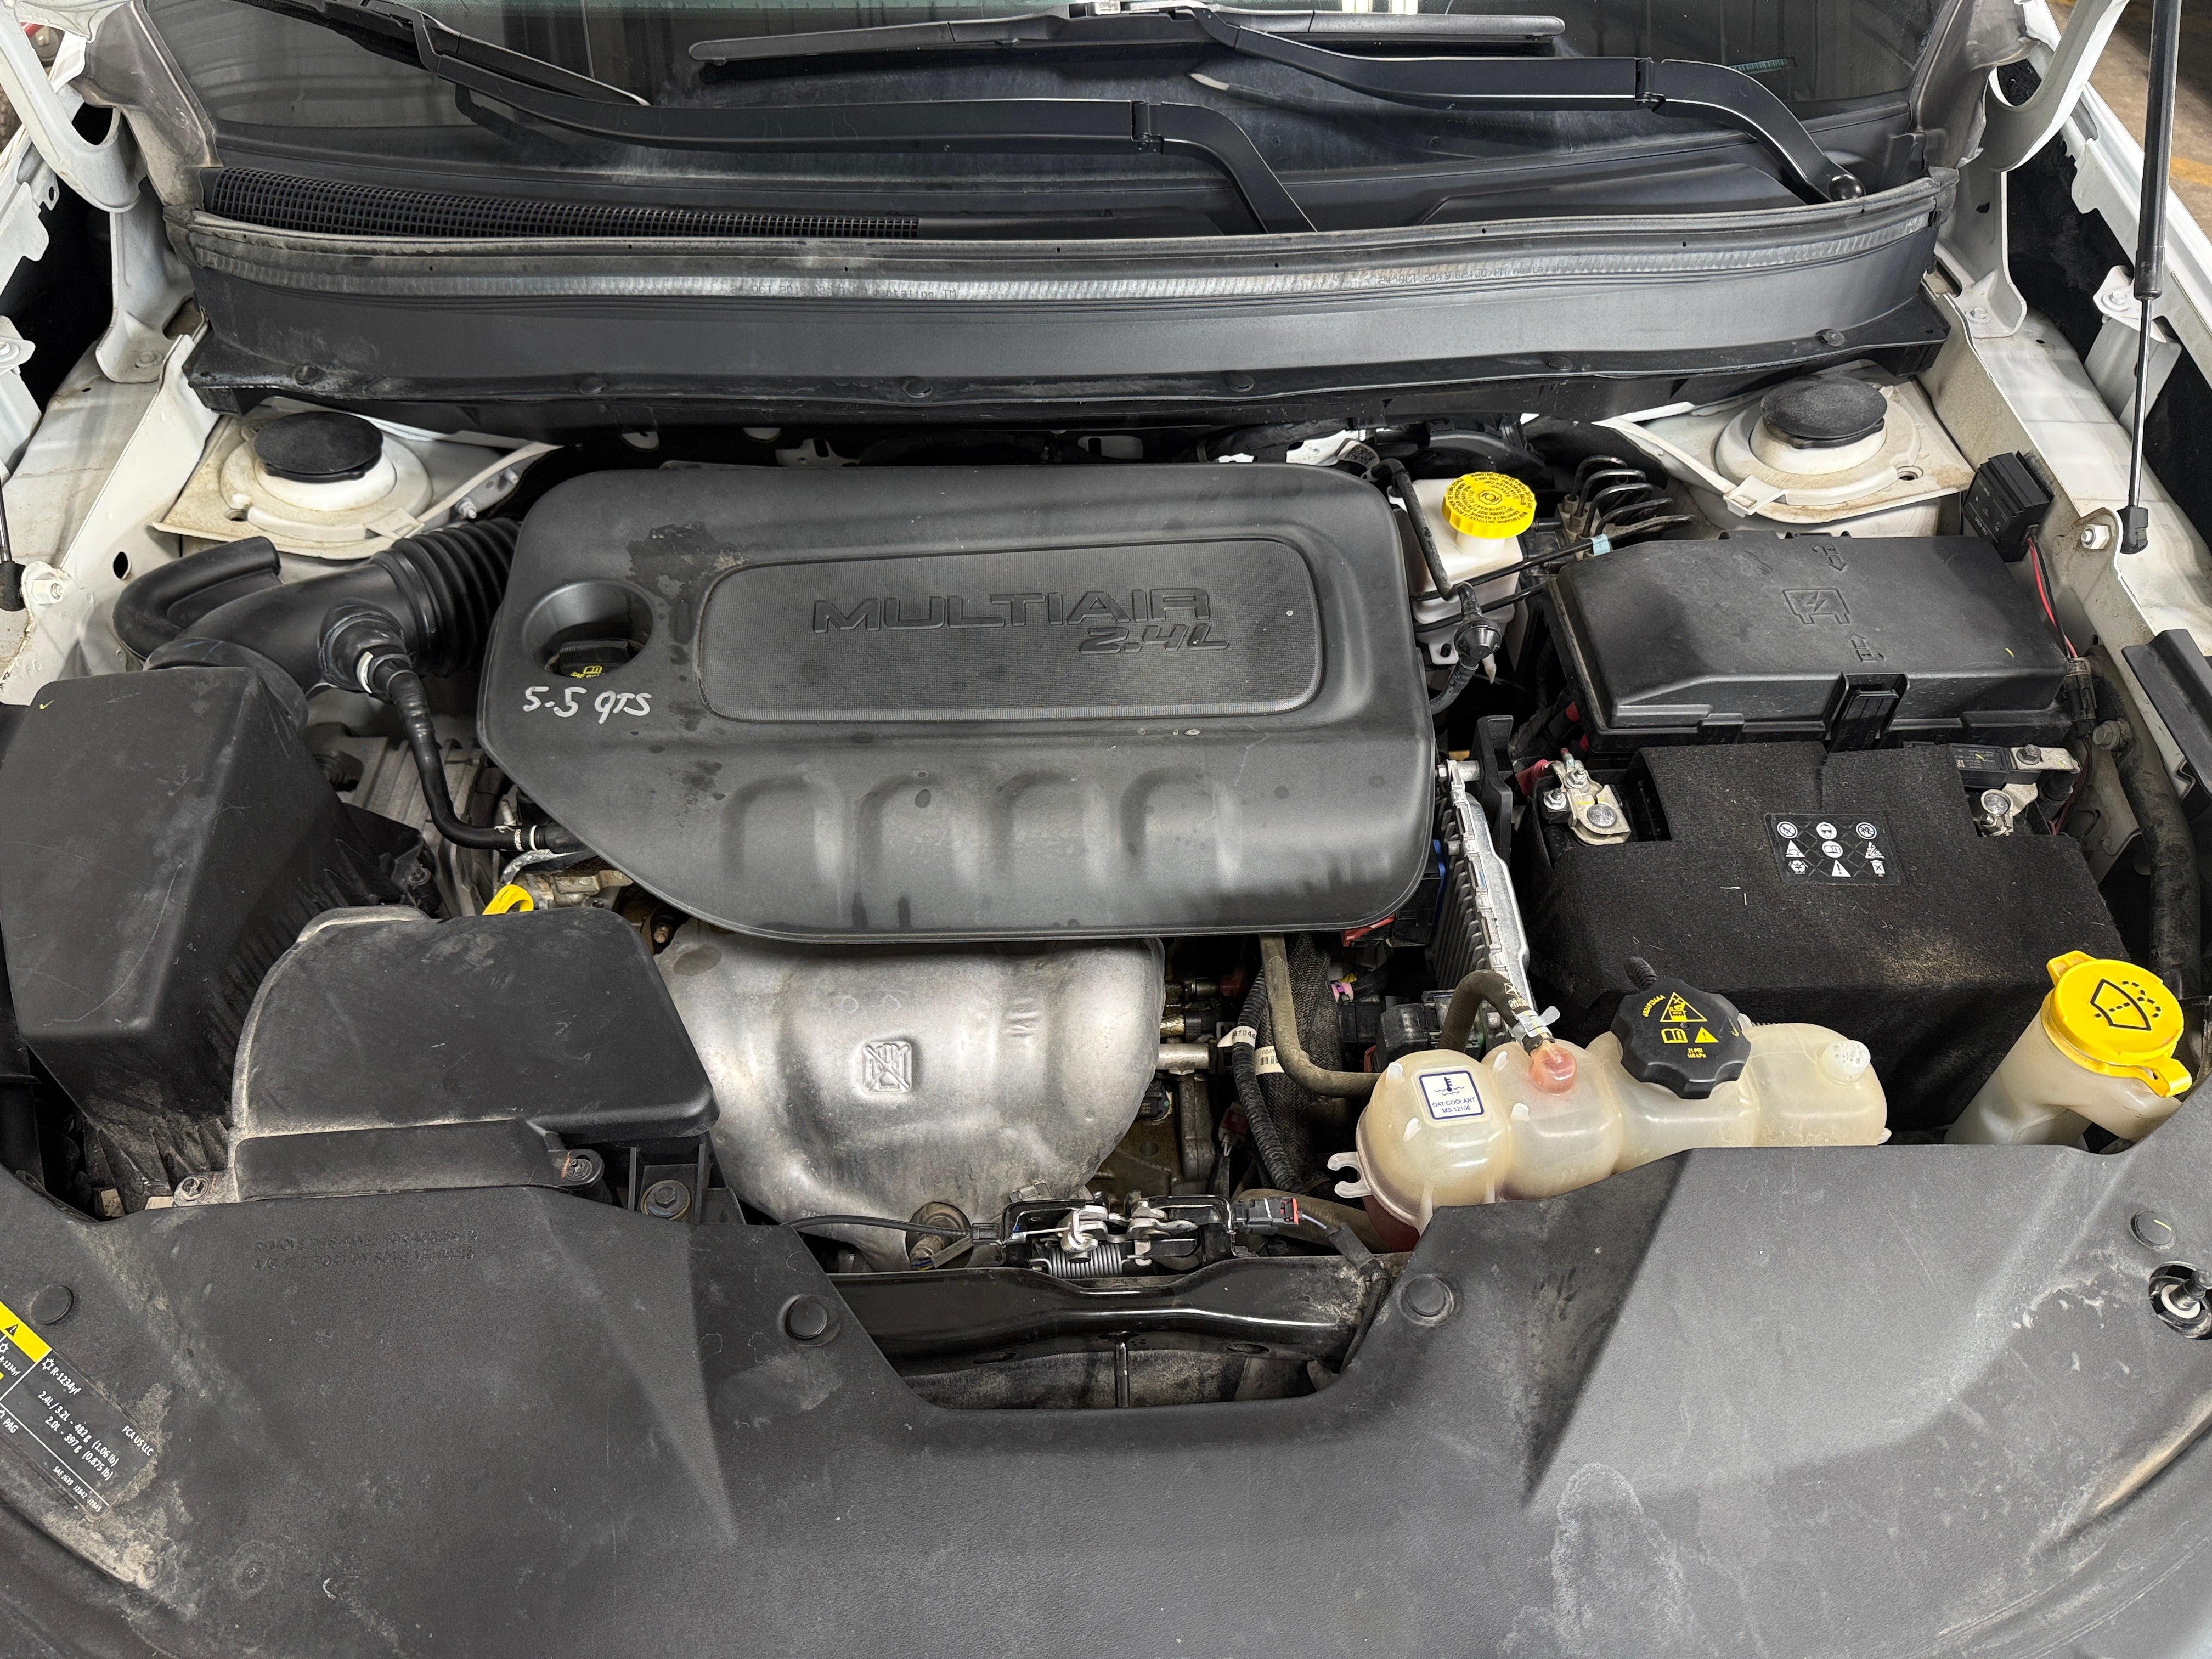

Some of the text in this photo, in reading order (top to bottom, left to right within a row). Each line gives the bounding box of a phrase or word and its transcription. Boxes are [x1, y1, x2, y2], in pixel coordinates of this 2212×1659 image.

[812, 586, 1212, 634] MULTIAIR
[1077, 623, 1230, 654] 2.4L
[522, 686, 588, 718] 5.5
[1442, 1105, 1471, 1113] MS-12106
[1446, 1097, 1475, 1106] COOLANT
[0, 1356, 21, 1377] R-1234yf
[50, 1367, 82, 1395] R-1234yf
[2, 1418, 19, 1434] PAG
[38, 1391, 54, 1407] 2.4L
[54, 1406, 70, 1422] 3.2L
[74, 1424, 88, 1438] 482
[83, 1435, 92, 1443] g
[91, 1440, 111, 1458] (1.06
[107, 1453, 120, 1467] lb)
[122, 1425, 154, 1457] FCA US LLC
[44, 1415, 61, 1432] 2.0L
[64, 1433, 79, 1447] 397
[74, 1444, 83, 1453] g
[82, 1450, 105, 1472] (0.875
[101, 1468, 114, 1481] lb)
[53, 1466, 64, 1477] SAE
[60, 1473, 75, 1486] J639
[72, 1484, 88, 1500] J2842
